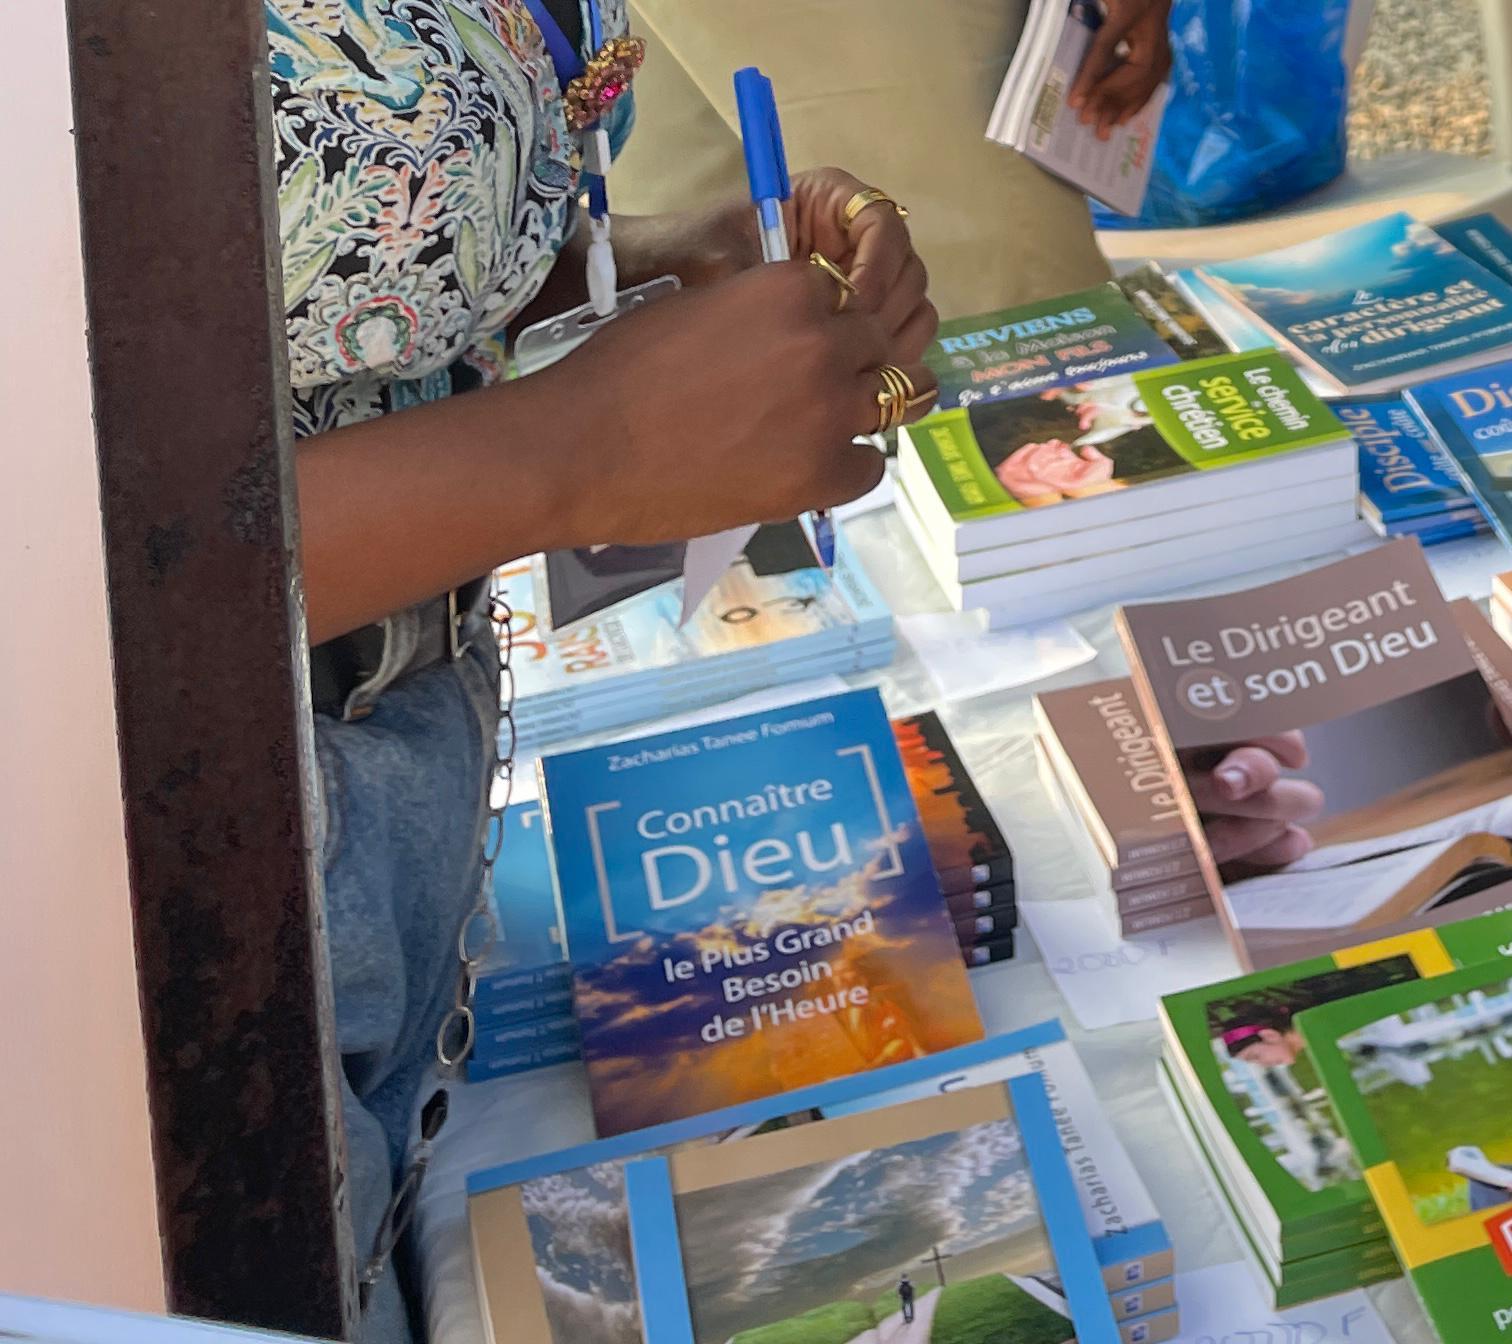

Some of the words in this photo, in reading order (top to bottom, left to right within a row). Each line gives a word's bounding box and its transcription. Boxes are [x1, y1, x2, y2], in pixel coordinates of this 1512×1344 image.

[938, 306, 1097, 354] REVIENS
[1287, 291, 1438, 335] caractère
[1331, 288, 1490, 338] personnalité
[1359, 297, 1506, 345] dirigeant
[971, 354, 1051, 383] MON
[1054, 339, 1114, 362] FILS
[1243, 366, 1274, 386] Le
[1161, 383, 1229, 451] chrétien
[1198, 375, 1273, 441] service
[1256, 383, 1311, 432] chemin
[1338, 407, 1433, 494] Disciple
[1161, 634, 1214, 667] Le
[1219, 576, 1418, 660] Dirigeant
[1186, 674, 1236, 709] et
[1244, 657, 1328, 704] son
[1331, 620, 1439, 677] Dieu
[607, 740, 700, 773] Zacharias
[700, 731, 758, 752] Tanee
[760, 710, 835, 739] Fomum
[1088, 691, 1174, 794] Dirigeant
[635, 775, 834, 841] Connaître
[639, 818, 856, 912] Dieu
[662, 954, 695, 984] le
[700, 937, 770, 974] Plus
[774, 911, 876, 955] Grand
[721, 957, 834, 1004] Besoin
[700, 1010, 744, 1044] de
[750, 983, 871, 1035] l'Heure
[1052, 1106, 1086, 1156] Tanee
[1074, 1155, 1129, 1238] Zacharias
